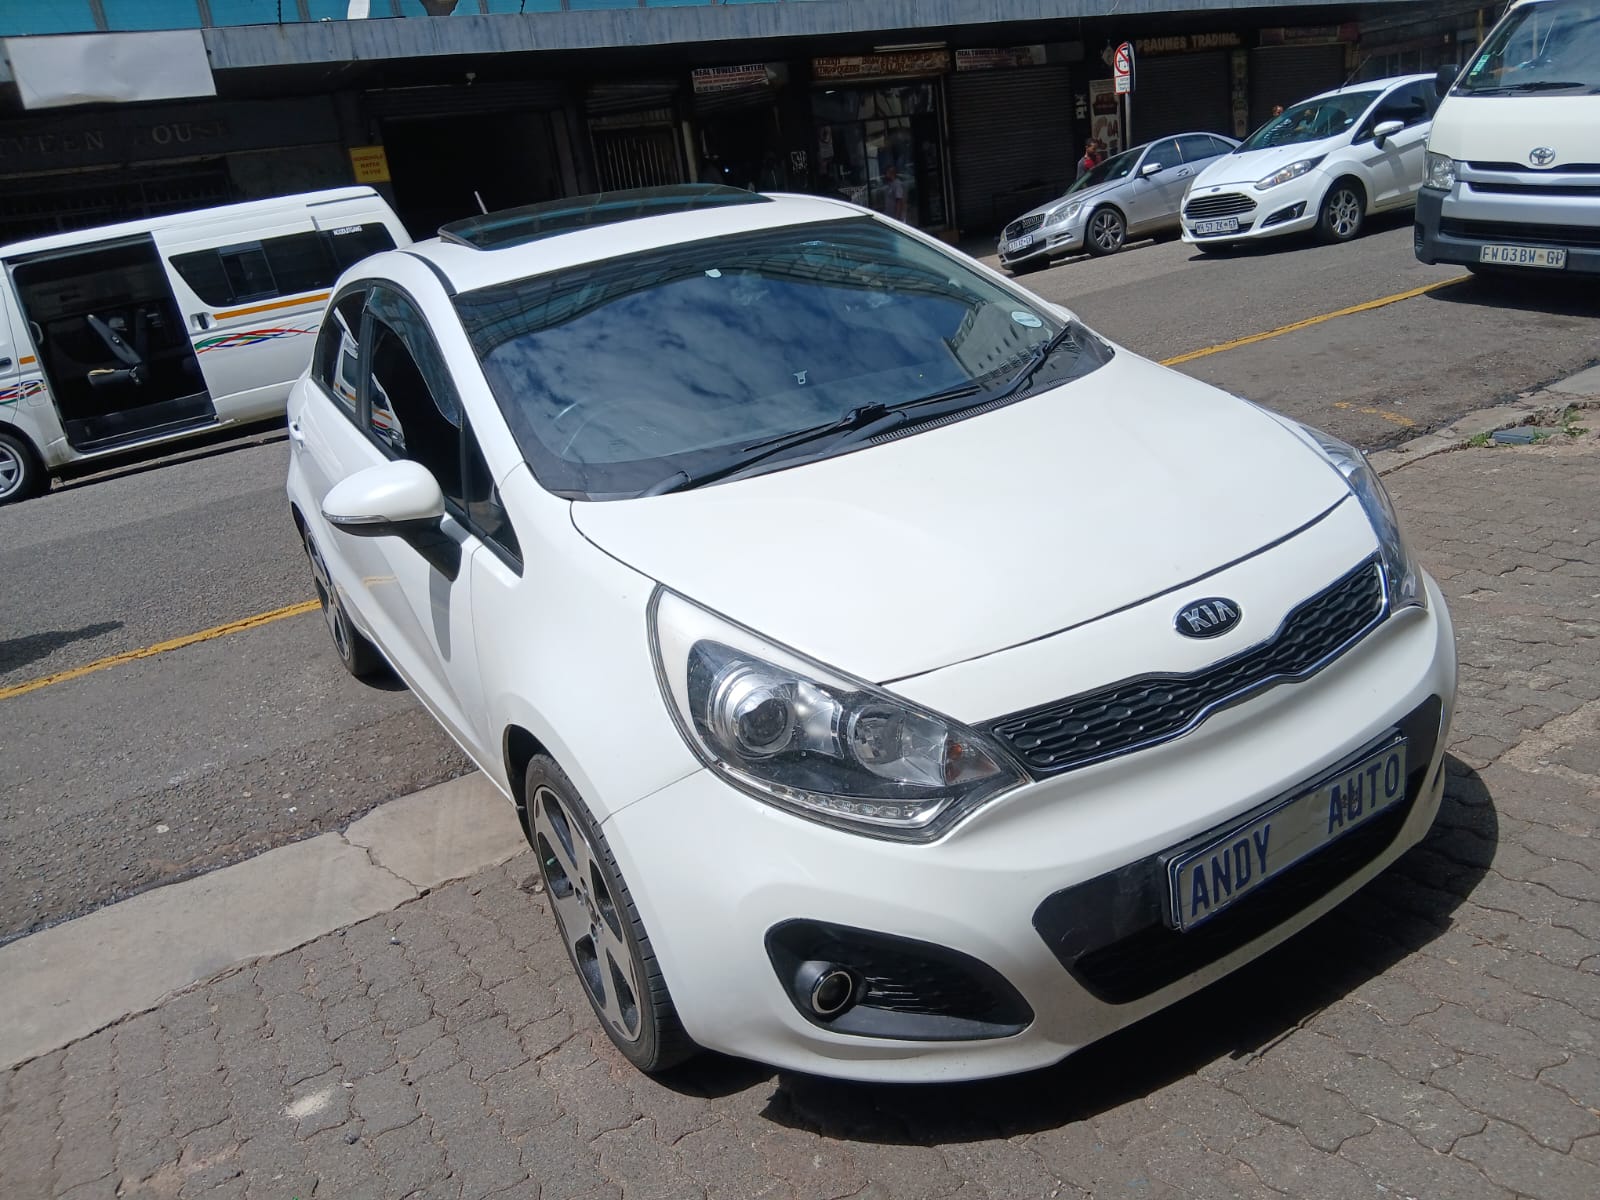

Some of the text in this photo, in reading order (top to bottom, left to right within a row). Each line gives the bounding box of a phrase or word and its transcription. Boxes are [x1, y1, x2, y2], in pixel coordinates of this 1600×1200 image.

[1191, 32, 1237, 48] TRADING
[1546, 250, 1564, 265] GP
[1182, 600, 1236, 633] KIA
[1191, 752, 1400, 917] ANDY AUTO
